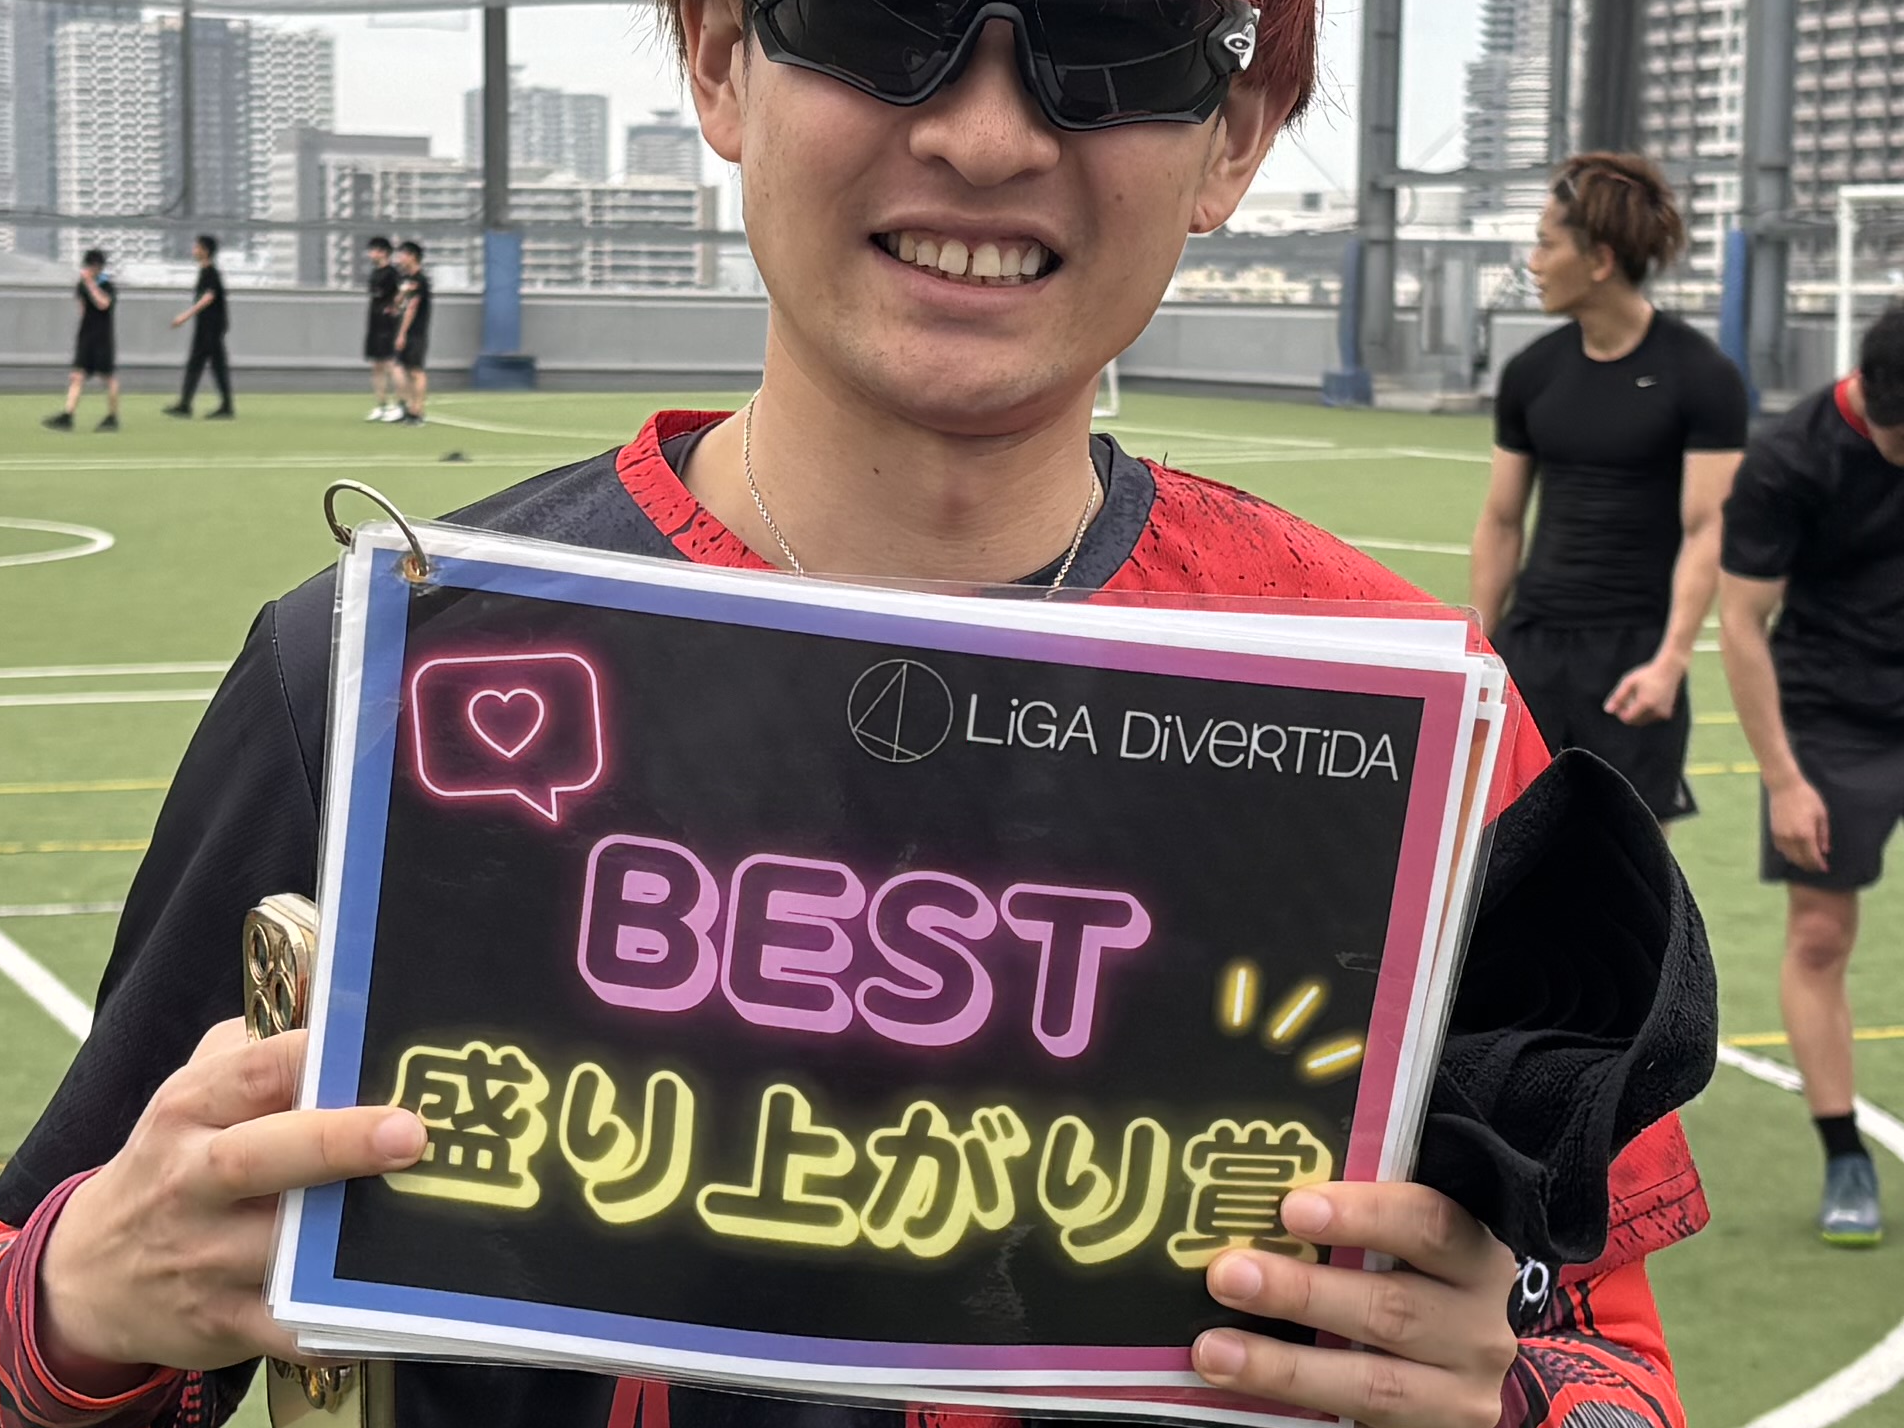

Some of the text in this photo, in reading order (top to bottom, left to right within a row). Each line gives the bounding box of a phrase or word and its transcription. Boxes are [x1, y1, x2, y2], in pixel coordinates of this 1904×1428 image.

[577, 833, 1152, 1059] BEST
[383, 1040, 1333, 1269] 盛り上がり賞
